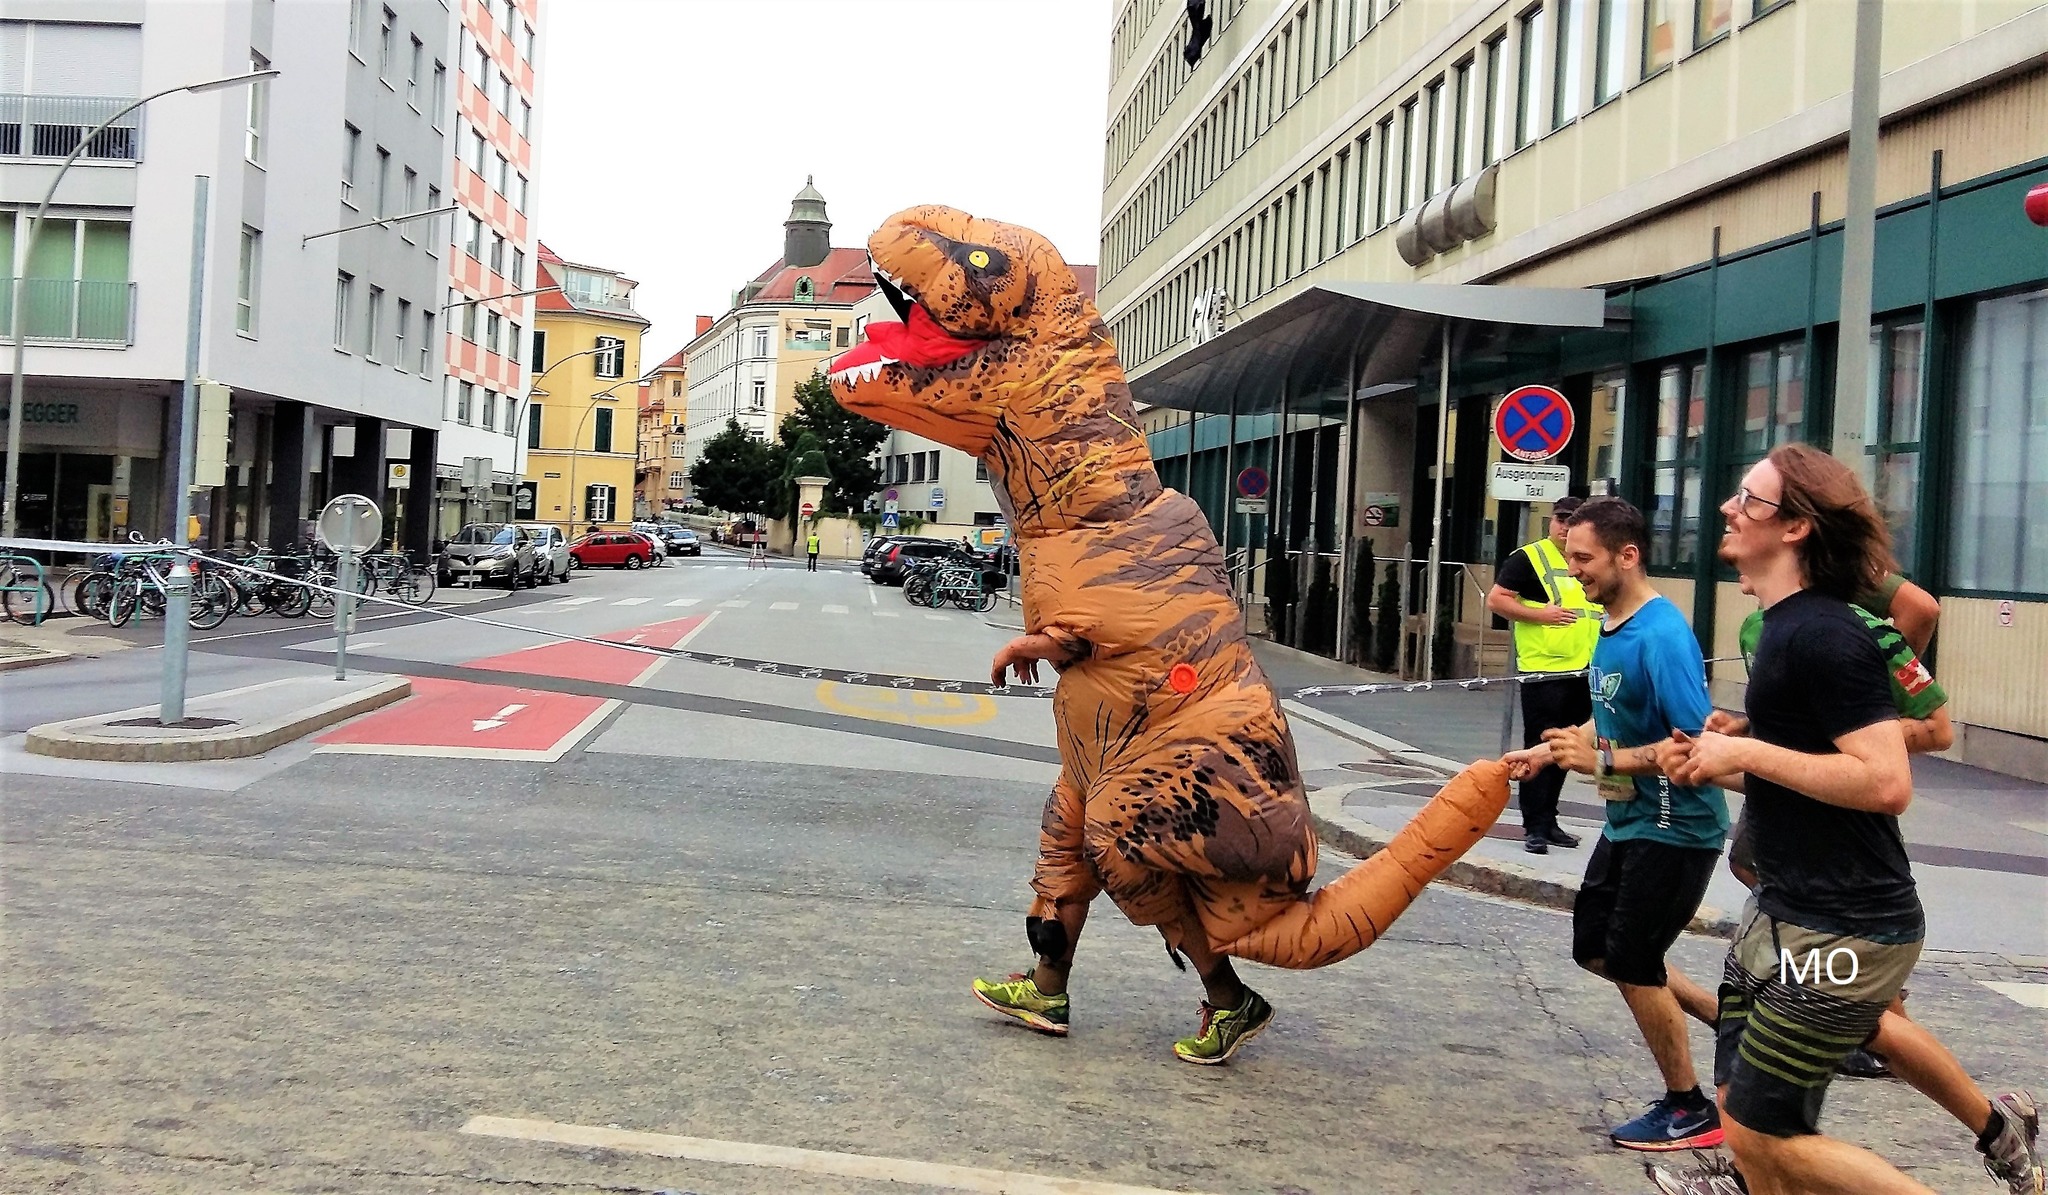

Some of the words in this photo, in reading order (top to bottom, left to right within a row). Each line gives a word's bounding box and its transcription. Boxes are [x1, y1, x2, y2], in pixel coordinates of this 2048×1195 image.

[1513, 448, 1550, 460] ANFANG
[1495, 466, 1567, 482] Ausgenommen
[1525, 484, 1544, 497] Taxi
